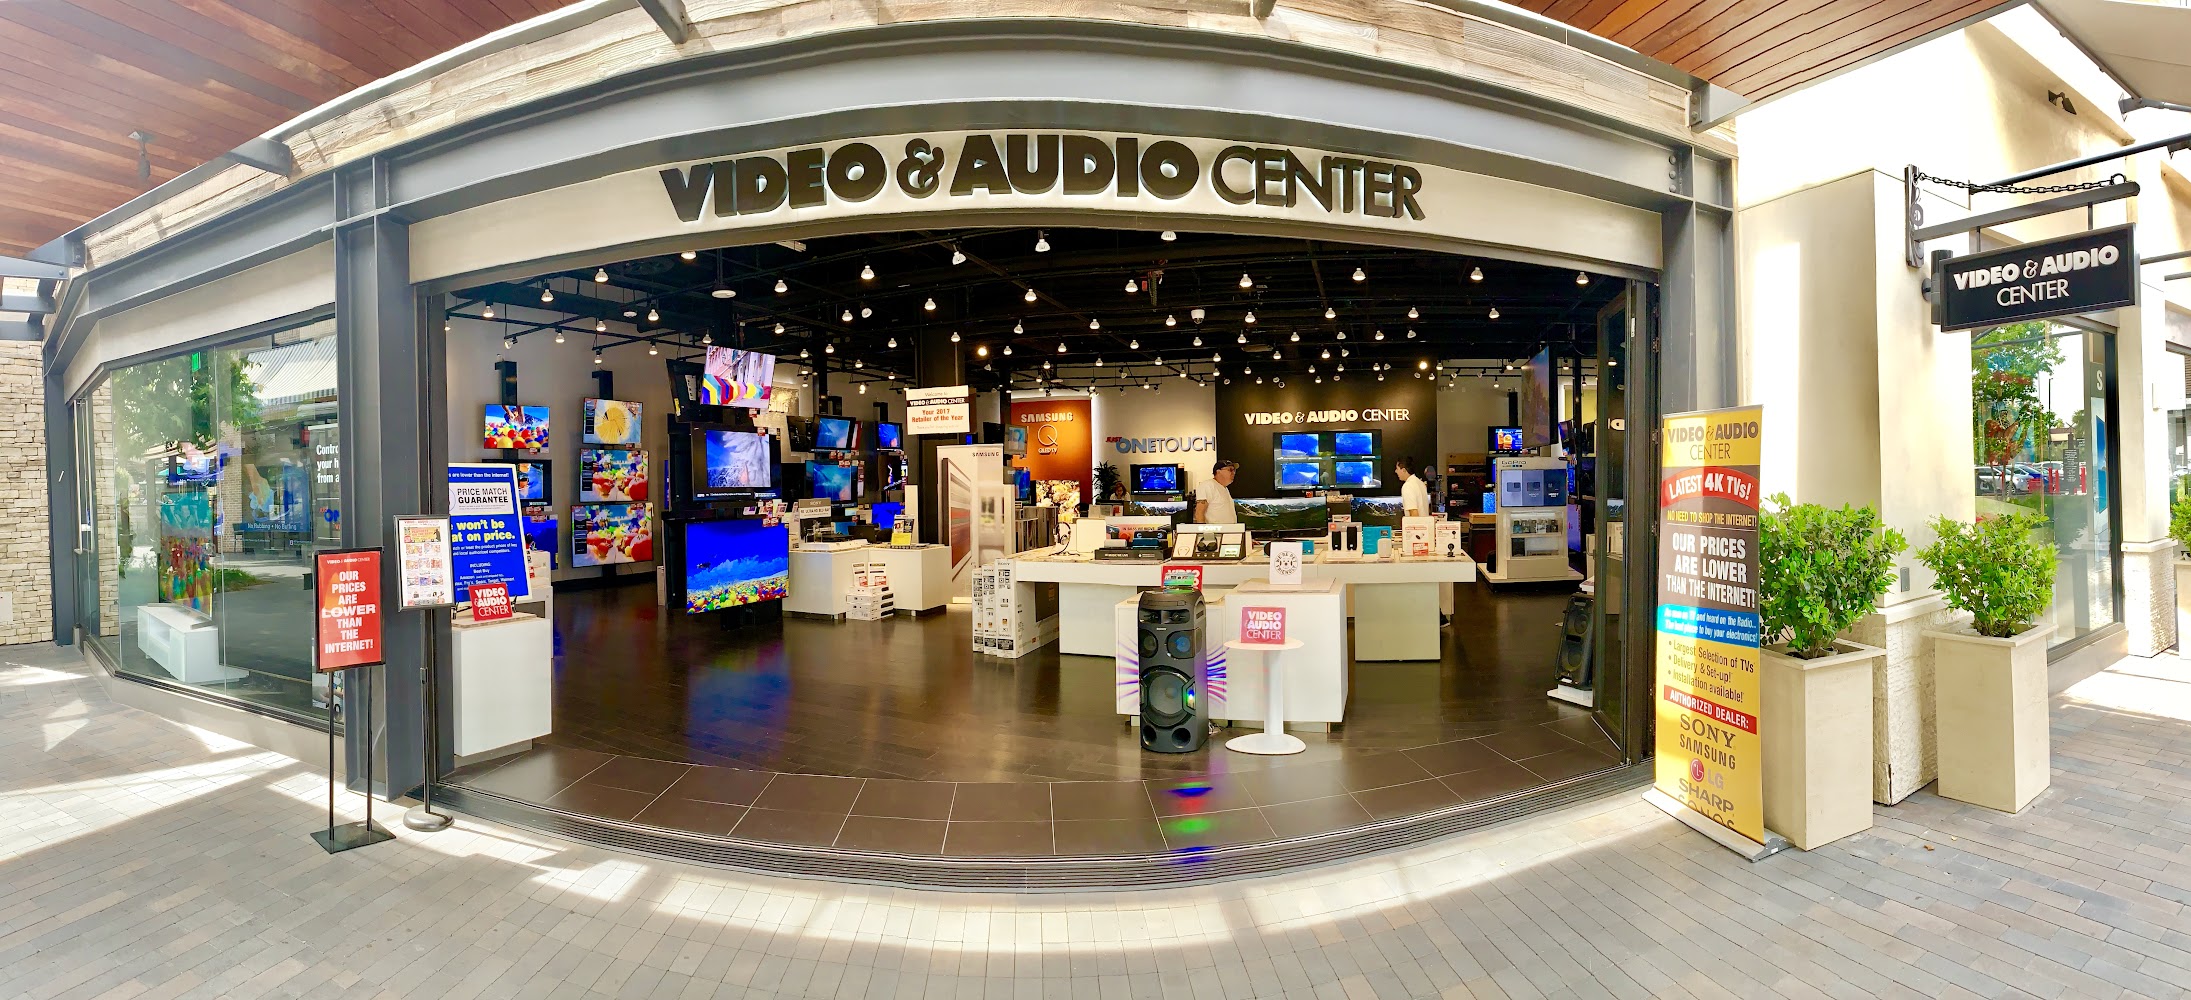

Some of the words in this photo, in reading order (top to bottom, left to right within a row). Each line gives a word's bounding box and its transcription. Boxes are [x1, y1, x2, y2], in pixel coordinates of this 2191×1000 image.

[659, 142, 888, 223] VIDEO
[896, 138, 945, 199] &
[950, 133, 1200, 200] AUDIO
[1211, 145, 1424, 222] CENTER
[1953, 263, 2020, 290] VIDEO
[2023, 260, 2039, 279] &
[2040, 245, 2119, 276] AUDIO
[1997, 279, 2070, 306] CENTER
[1021, 412, 1073, 423] SAMSUNG
[1244, 412, 1293, 425] VIDEO
[1295, 412, 1304, 424] &
[1306, 410, 1359, 422] AUDIO
[1362, 408, 1410, 421] CENTER
[1038, 424, 1058, 446] Q
[1668, 426, 1704, 443] VIDEO
[1706, 425, 1714, 441] &
[1715, 421, 1759, 440] AUDIO
[1690, 443, 1731, 460] CENTER
[317, 461, 332, 471] your
[317, 473, 333, 483] from
[1669, 474, 1702, 500] LATEST
[1705, 473, 1724, 492] 4K
[1727, 476, 1752, 500] TVs!
[456, 519, 488, 530] won't
[491, 519, 505, 529] be
[1667, 510, 1675, 520] NO
[1676, 511, 1688, 522] NEED
[1690, 512, 1697, 522] TO
[1699, 512, 1712, 524] SHOP
[1714, 512, 1724, 524] THE
[1726, 513, 1757, 527] INTERNET!
[484, 530, 515, 543] price.
[1672, 533, 1695, 553] OUR
[1700, 535, 1746, 559] PRICES
[339, 571, 358, 581] OUR
[1675, 554, 1698, 576] ARE
[1702, 558, 1747, 584] LOWER
[332, 582, 366, 594] PRICES
[475, 587, 506, 598] VIDEO
[1666, 574, 1686, 595] THAN
[1689, 578, 1706, 599] THE
[1708, 581, 1755, 608] INTERNET!
[338, 594, 357, 605] ARE
[478, 597, 507, 607] AUDIO
[322, 604, 376, 619] LOWER
[479, 605, 509, 616] CENTER
[1248, 611, 1282, 620] VIDEO
[1696, 613, 1705, 621] and
[1706, 613, 1718, 623] heard
[1720, 616, 1726, 624] on
[1728, 615, 1736, 625] the
[336, 617, 362, 628] THAN
[1247, 621, 1281, 630] AUDIO
[340, 629, 358, 640] THE
[1246, 630, 1281, 640] CENTER
[1699, 625, 1704, 633] to
[1714, 629, 1725, 638] your
[1726, 628, 1758, 642] electronics!
[325, 639, 373, 654] INTERNET!
[1673, 640, 1697, 656] Largest
[1698, 647, 1728, 666] Selection
[1730, 657, 1738, 668] of
[1740, 658, 1754, 673] TVs
[1673, 654, 1698, 673] Delivery
[1700, 663, 1705, 673] &
[1706, 665, 1731, 684] Set-up!
[1673, 669, 1708, 691] Installation
[1709, 683, 1743, 703] available!
[1670, 689, 1713, 715] AUTHORIZED
[1715, 706, 1749, 729] DEALER:
[1680, 714, 1736, 748] SONY
[1680, 734, 1736, 770] SAMSUNG
[1707, 769, 1724, 790] LG
[1679, 778, 1734, 813] SHARP
